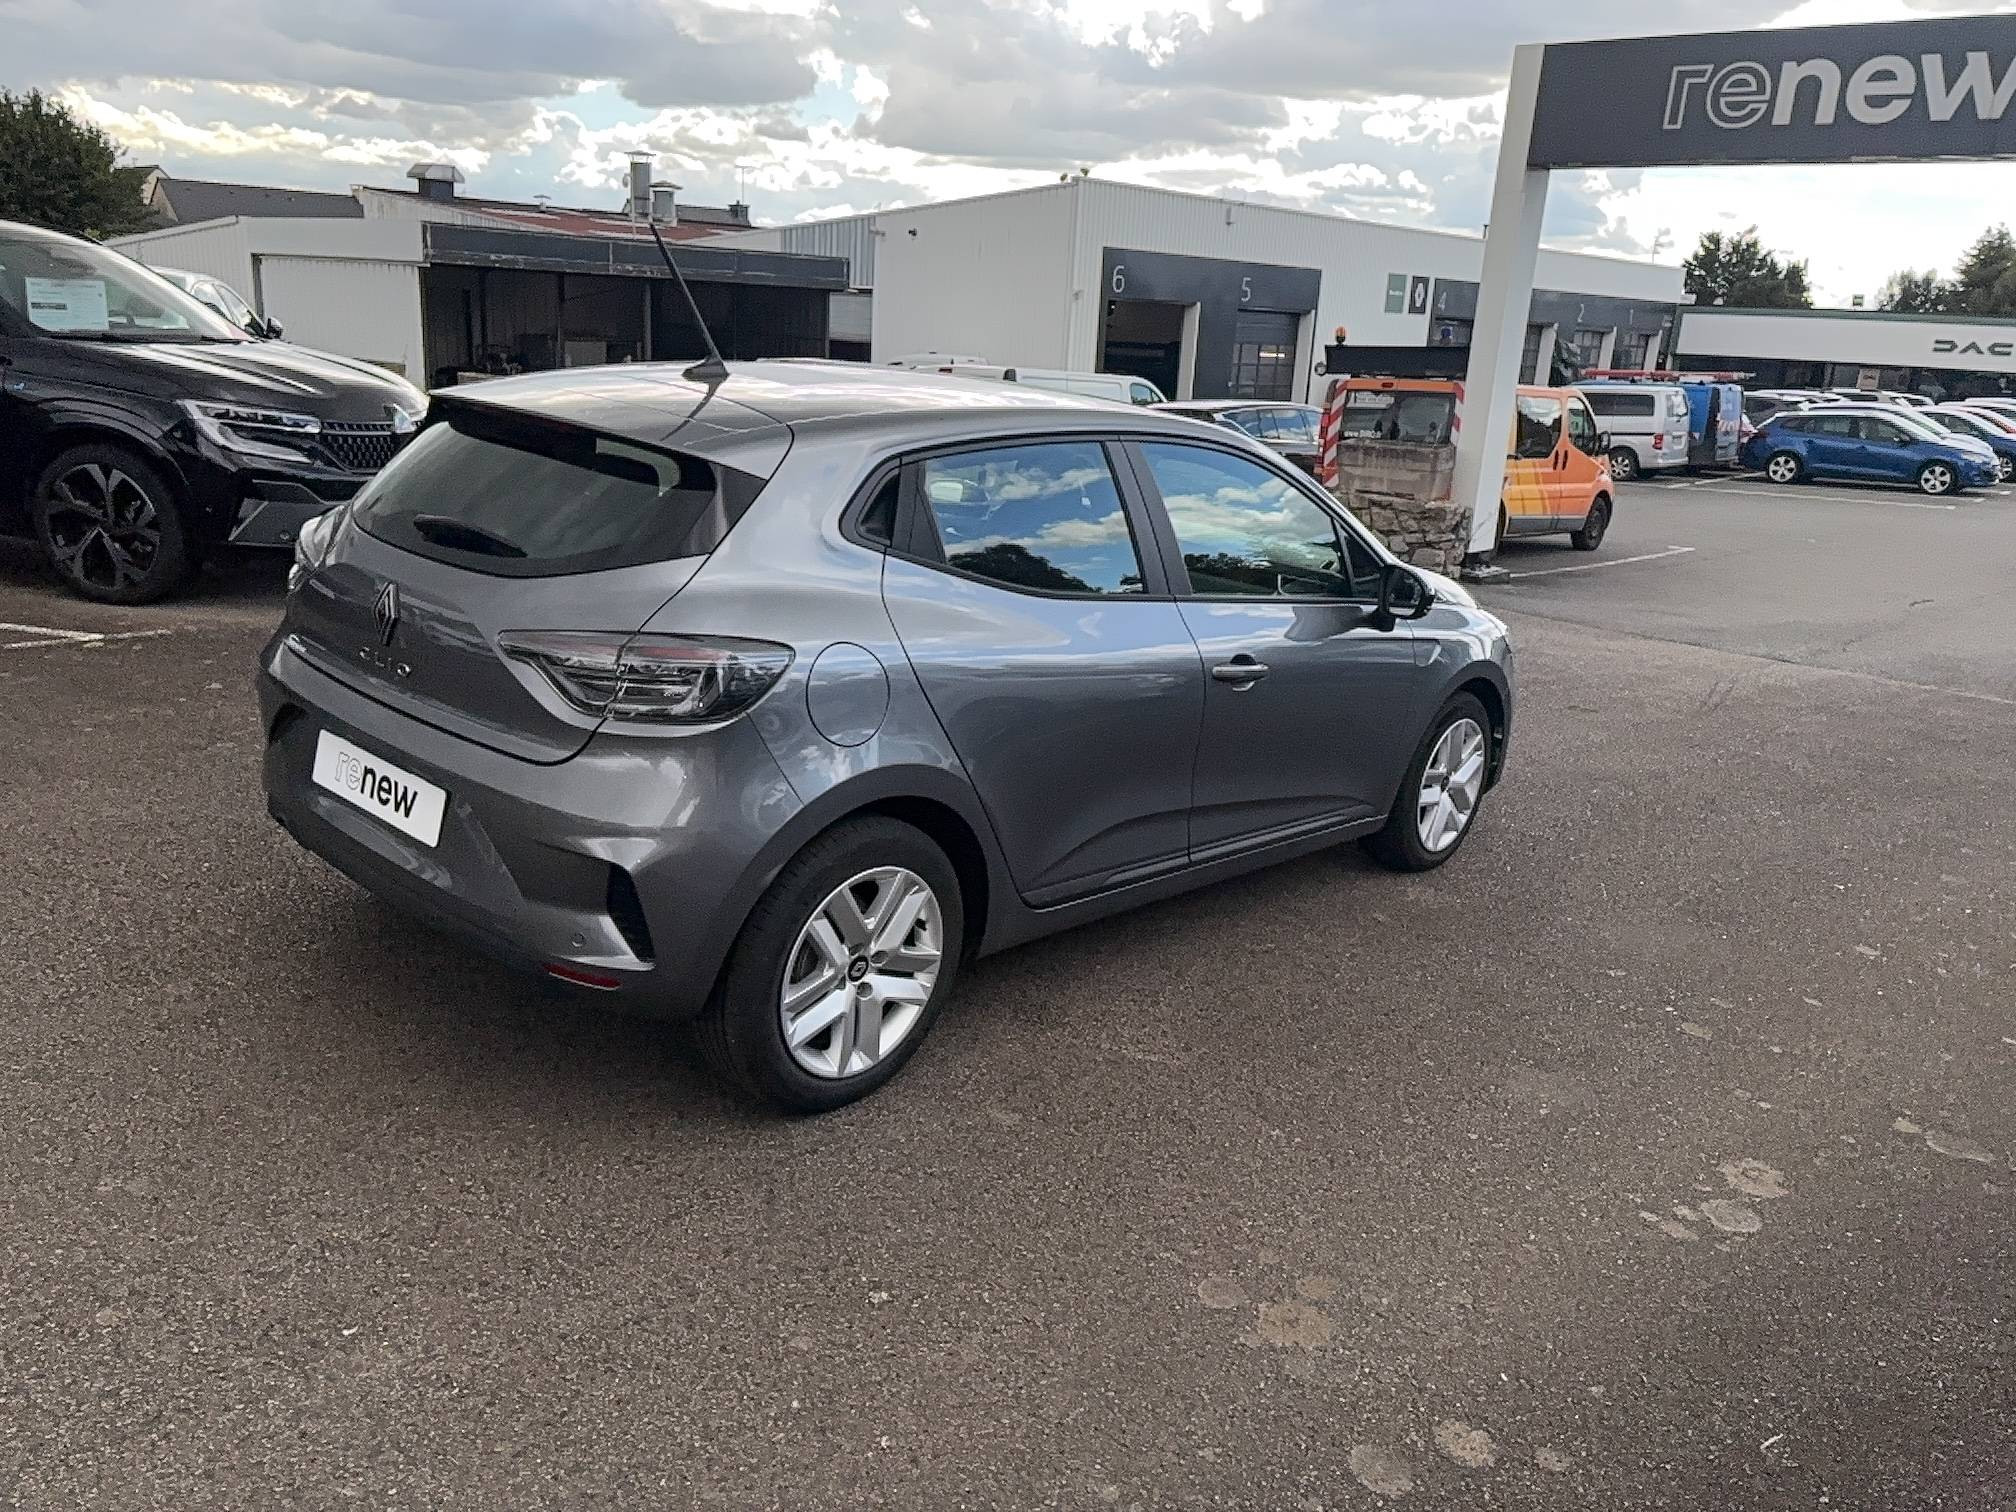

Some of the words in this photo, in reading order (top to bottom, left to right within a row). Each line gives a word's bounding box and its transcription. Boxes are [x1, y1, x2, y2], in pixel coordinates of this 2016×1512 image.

[1662, 50, 2016, 130] renew
[1112, 264, 1126, 293] 6
[1240, 276, 1251, 302] 5
[1932, 339, 2014, 356] DAC
[334, 751, 418, 818] renew
